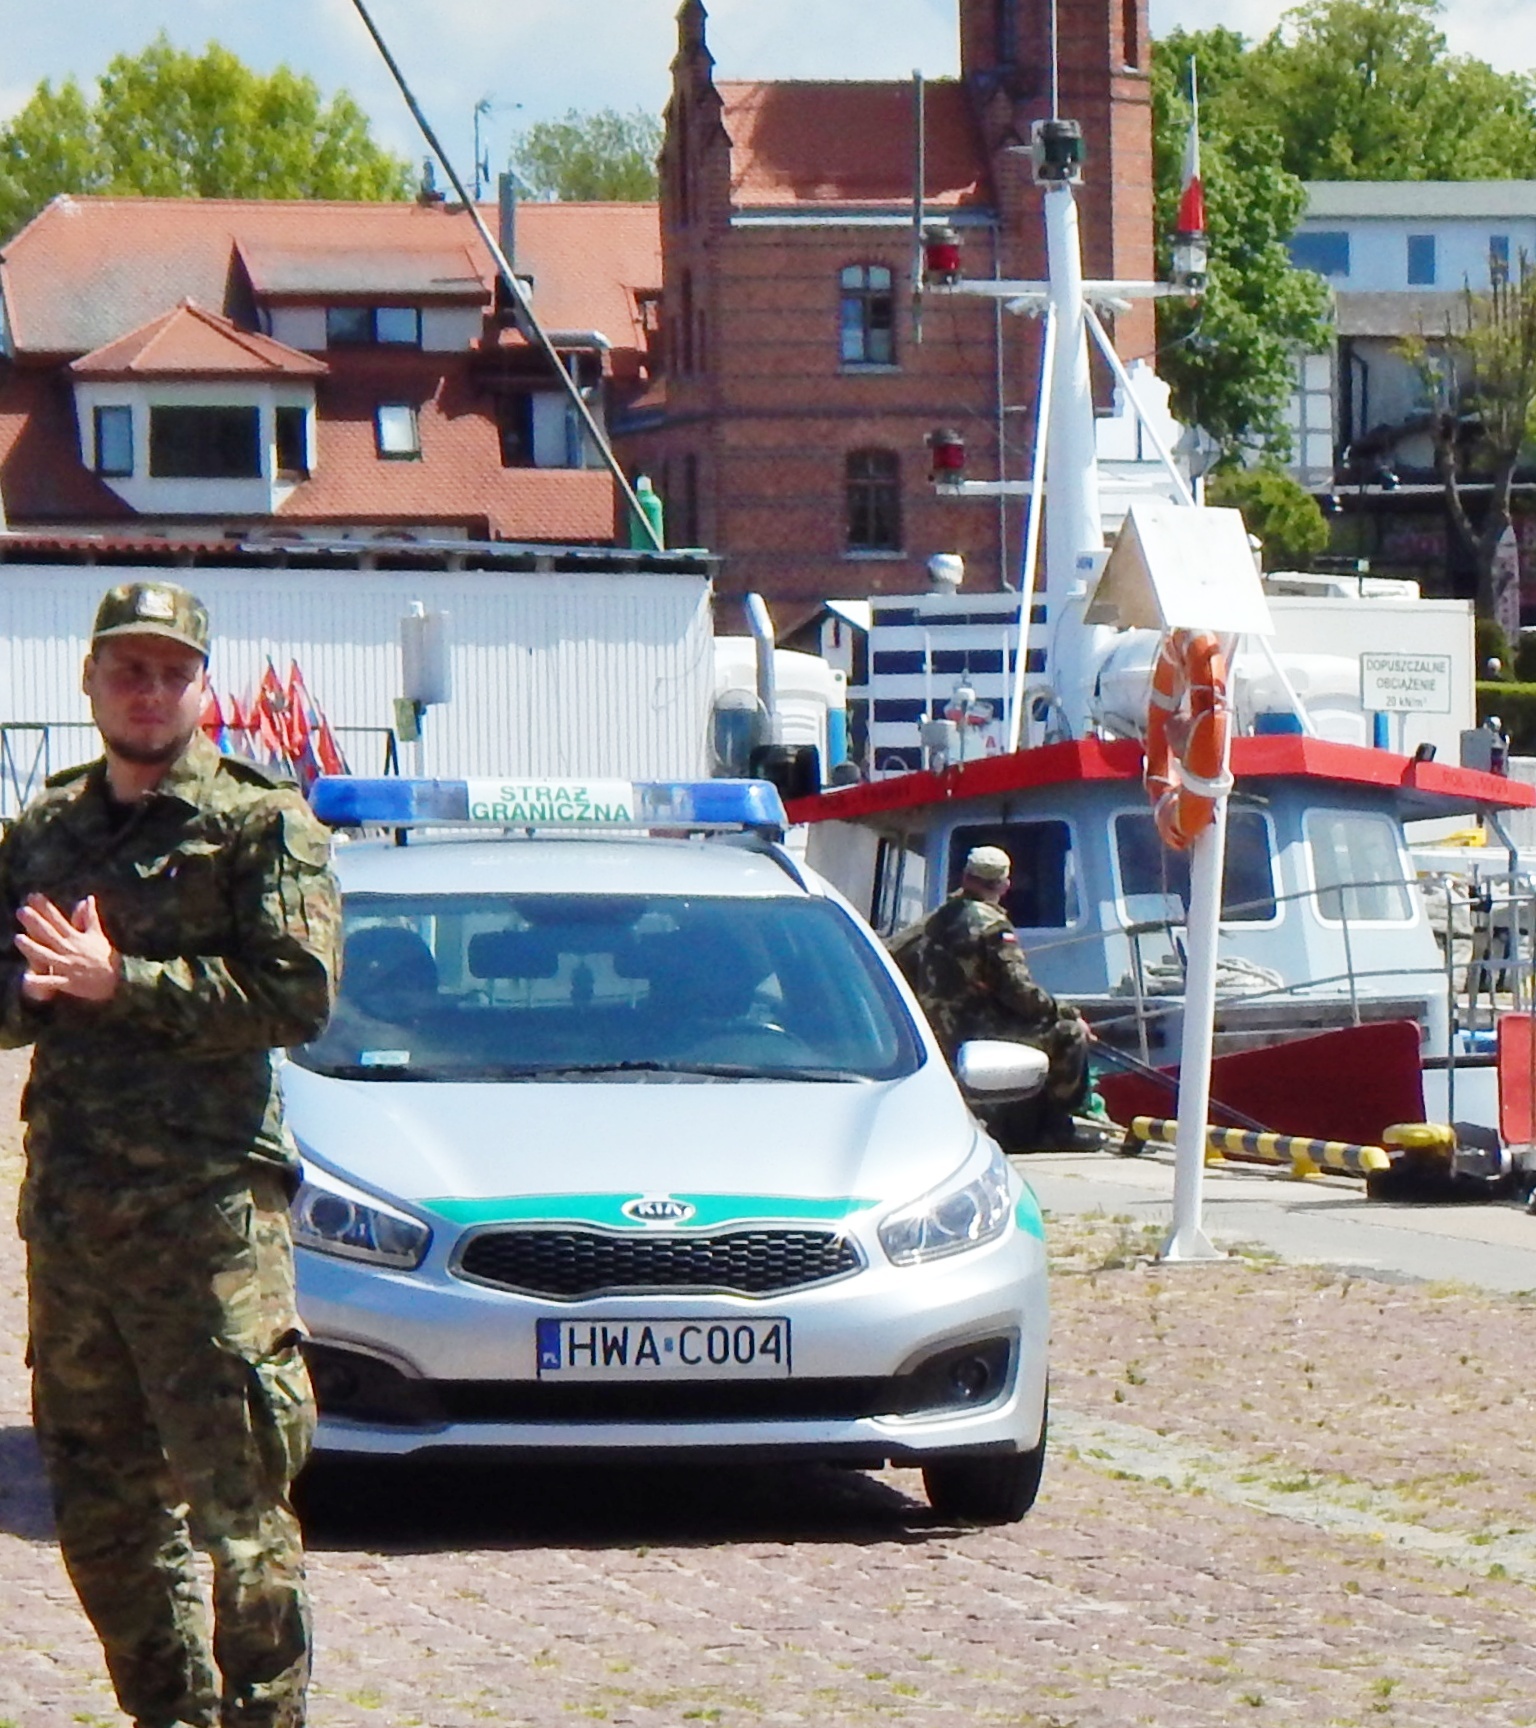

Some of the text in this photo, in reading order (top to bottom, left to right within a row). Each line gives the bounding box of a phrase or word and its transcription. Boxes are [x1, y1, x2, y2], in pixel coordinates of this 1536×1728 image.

[1366, 659, 1446, 673] DOPUSZCZALNE
[471, 802, 631, 822] GRANICZNA
[637, 1201, 683, 1216] KIA
[568, 1324, 782, 1366] HWA C004
